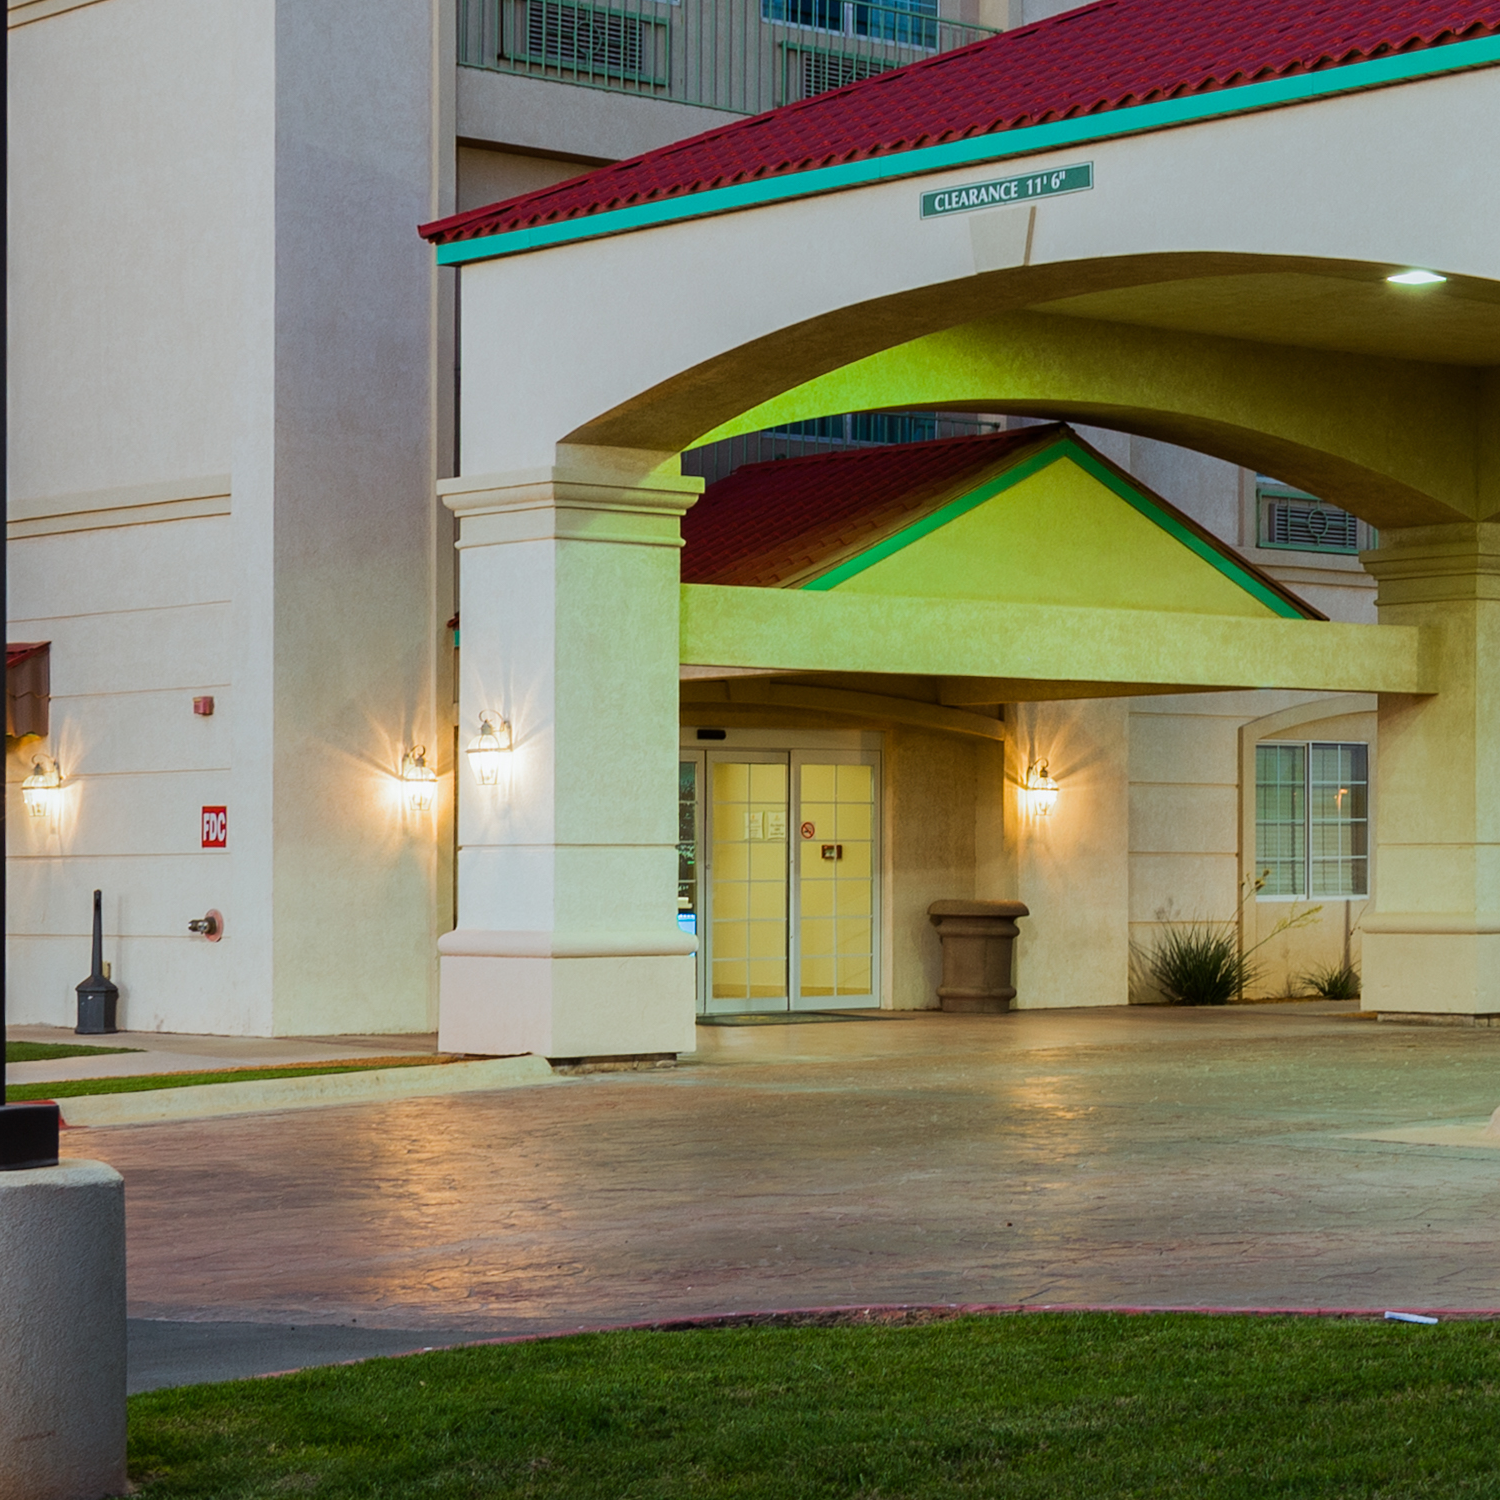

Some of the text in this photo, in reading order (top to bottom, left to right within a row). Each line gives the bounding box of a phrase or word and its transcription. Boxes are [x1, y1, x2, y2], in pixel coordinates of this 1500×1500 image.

[933, 170, 1066, 212] CLEARANCE 11' 6"
[203, 812, 226, 841] FDC
